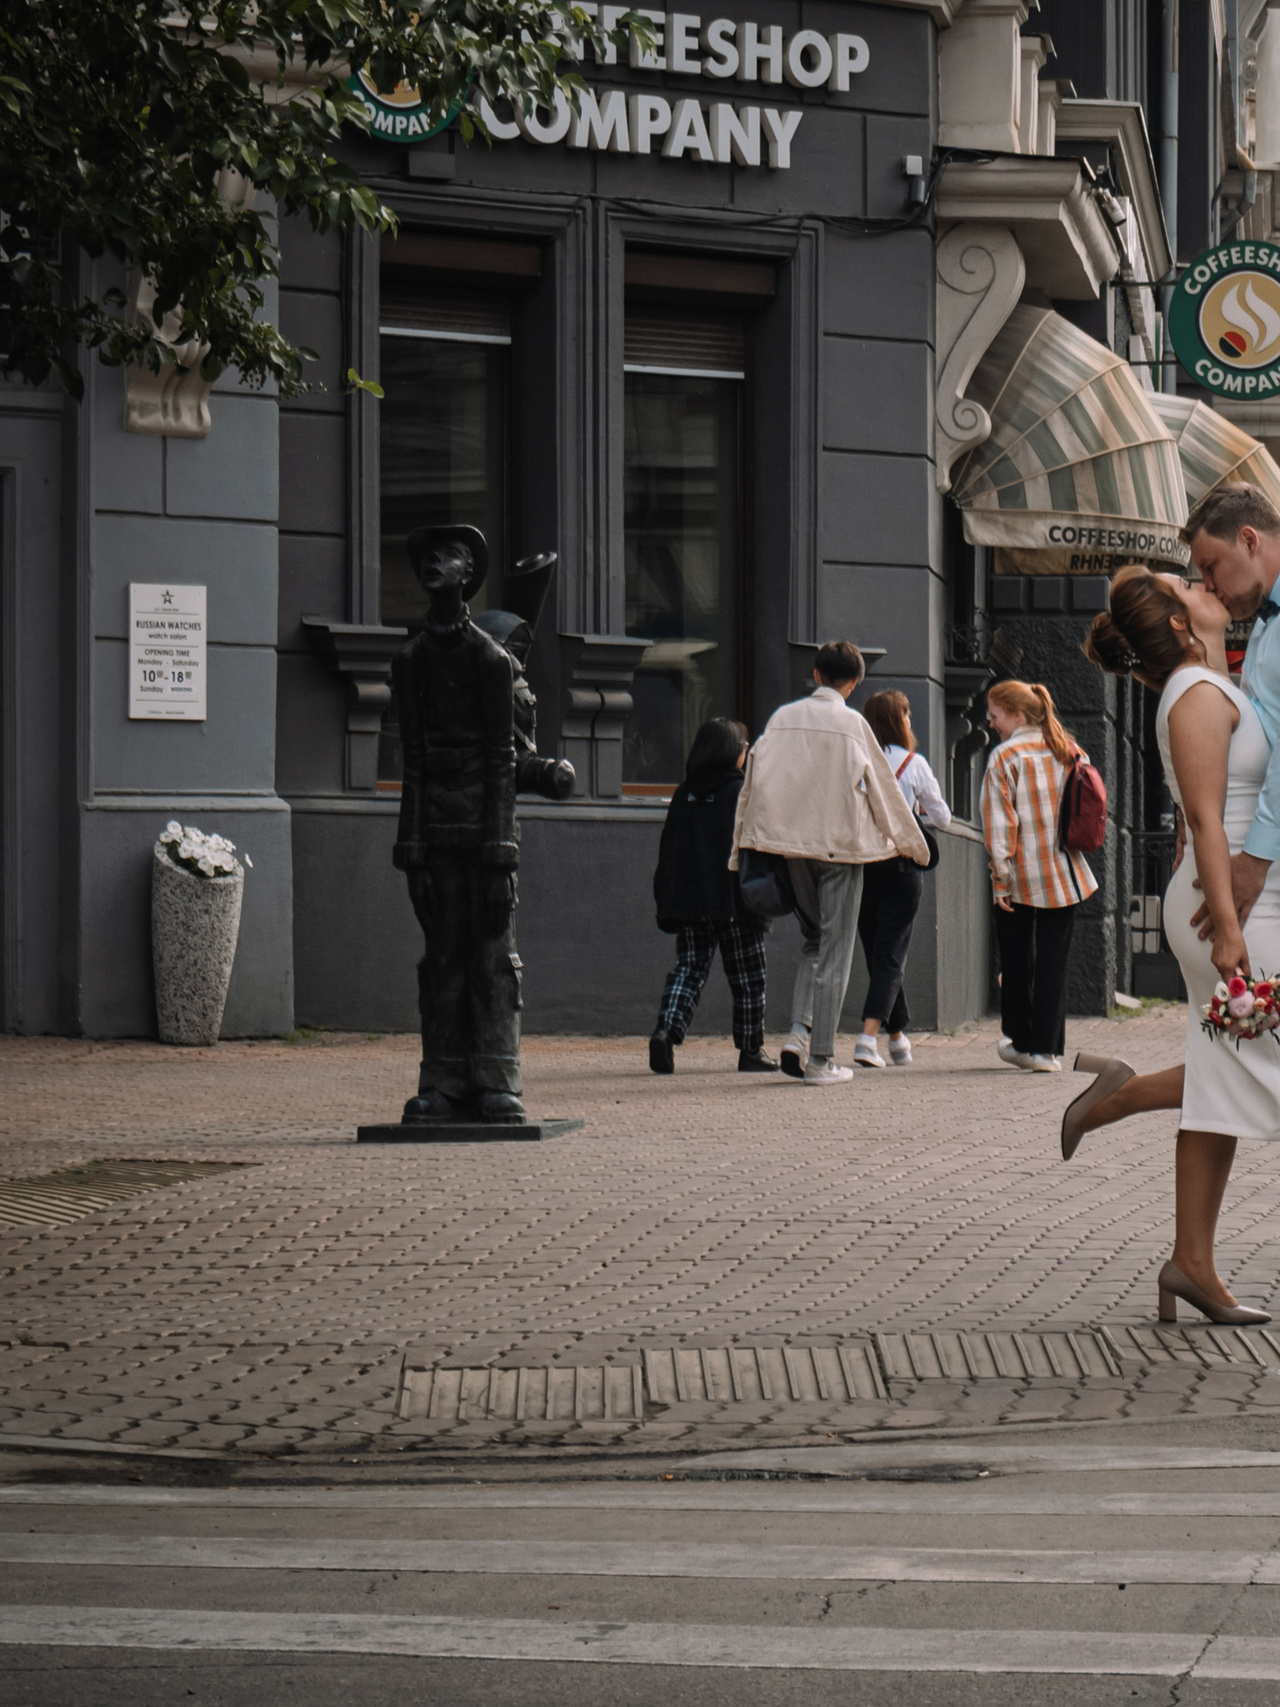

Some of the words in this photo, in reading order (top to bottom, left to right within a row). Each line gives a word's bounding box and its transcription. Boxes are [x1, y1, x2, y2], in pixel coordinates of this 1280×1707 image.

[512, 0, 870, 92] FFEESHOP
[477, 84, 804, 168] COMPANY
[1048, 525, 1156, 551] COFFEESHOP
[136, 620, 166, 630] RUSSIAN
[168, 621, 202, 631] WATCHES
[148, 632, 168, 640] watch
[144, 648, 174, 656] OPENING
[175, 649, 190, 657] TIME
[137, 658, 163, 667] Monday
[172, 659, 199, 668] Saturday
[140, 685, 164, 694] Sunday
